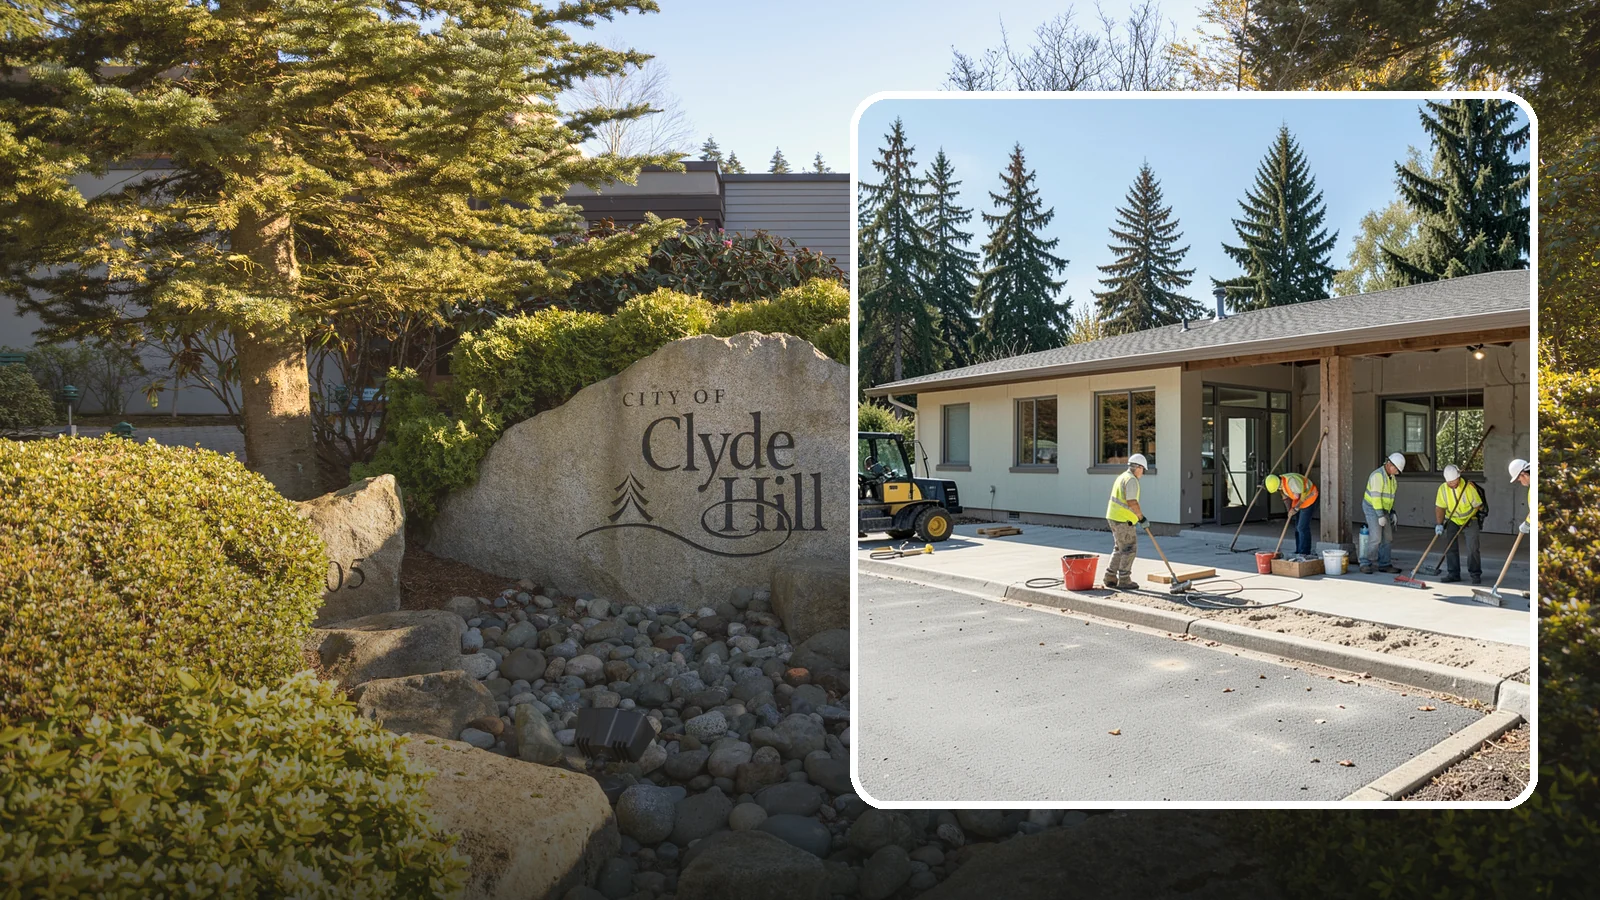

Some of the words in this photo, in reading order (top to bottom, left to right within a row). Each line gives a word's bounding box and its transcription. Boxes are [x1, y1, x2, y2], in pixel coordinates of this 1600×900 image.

[623, 390, 680, 407] CITY
[694, 389, 726, 404] OF
[642, 411, 795, 492] Clyde
[718, 472, 828, 532] Hill
